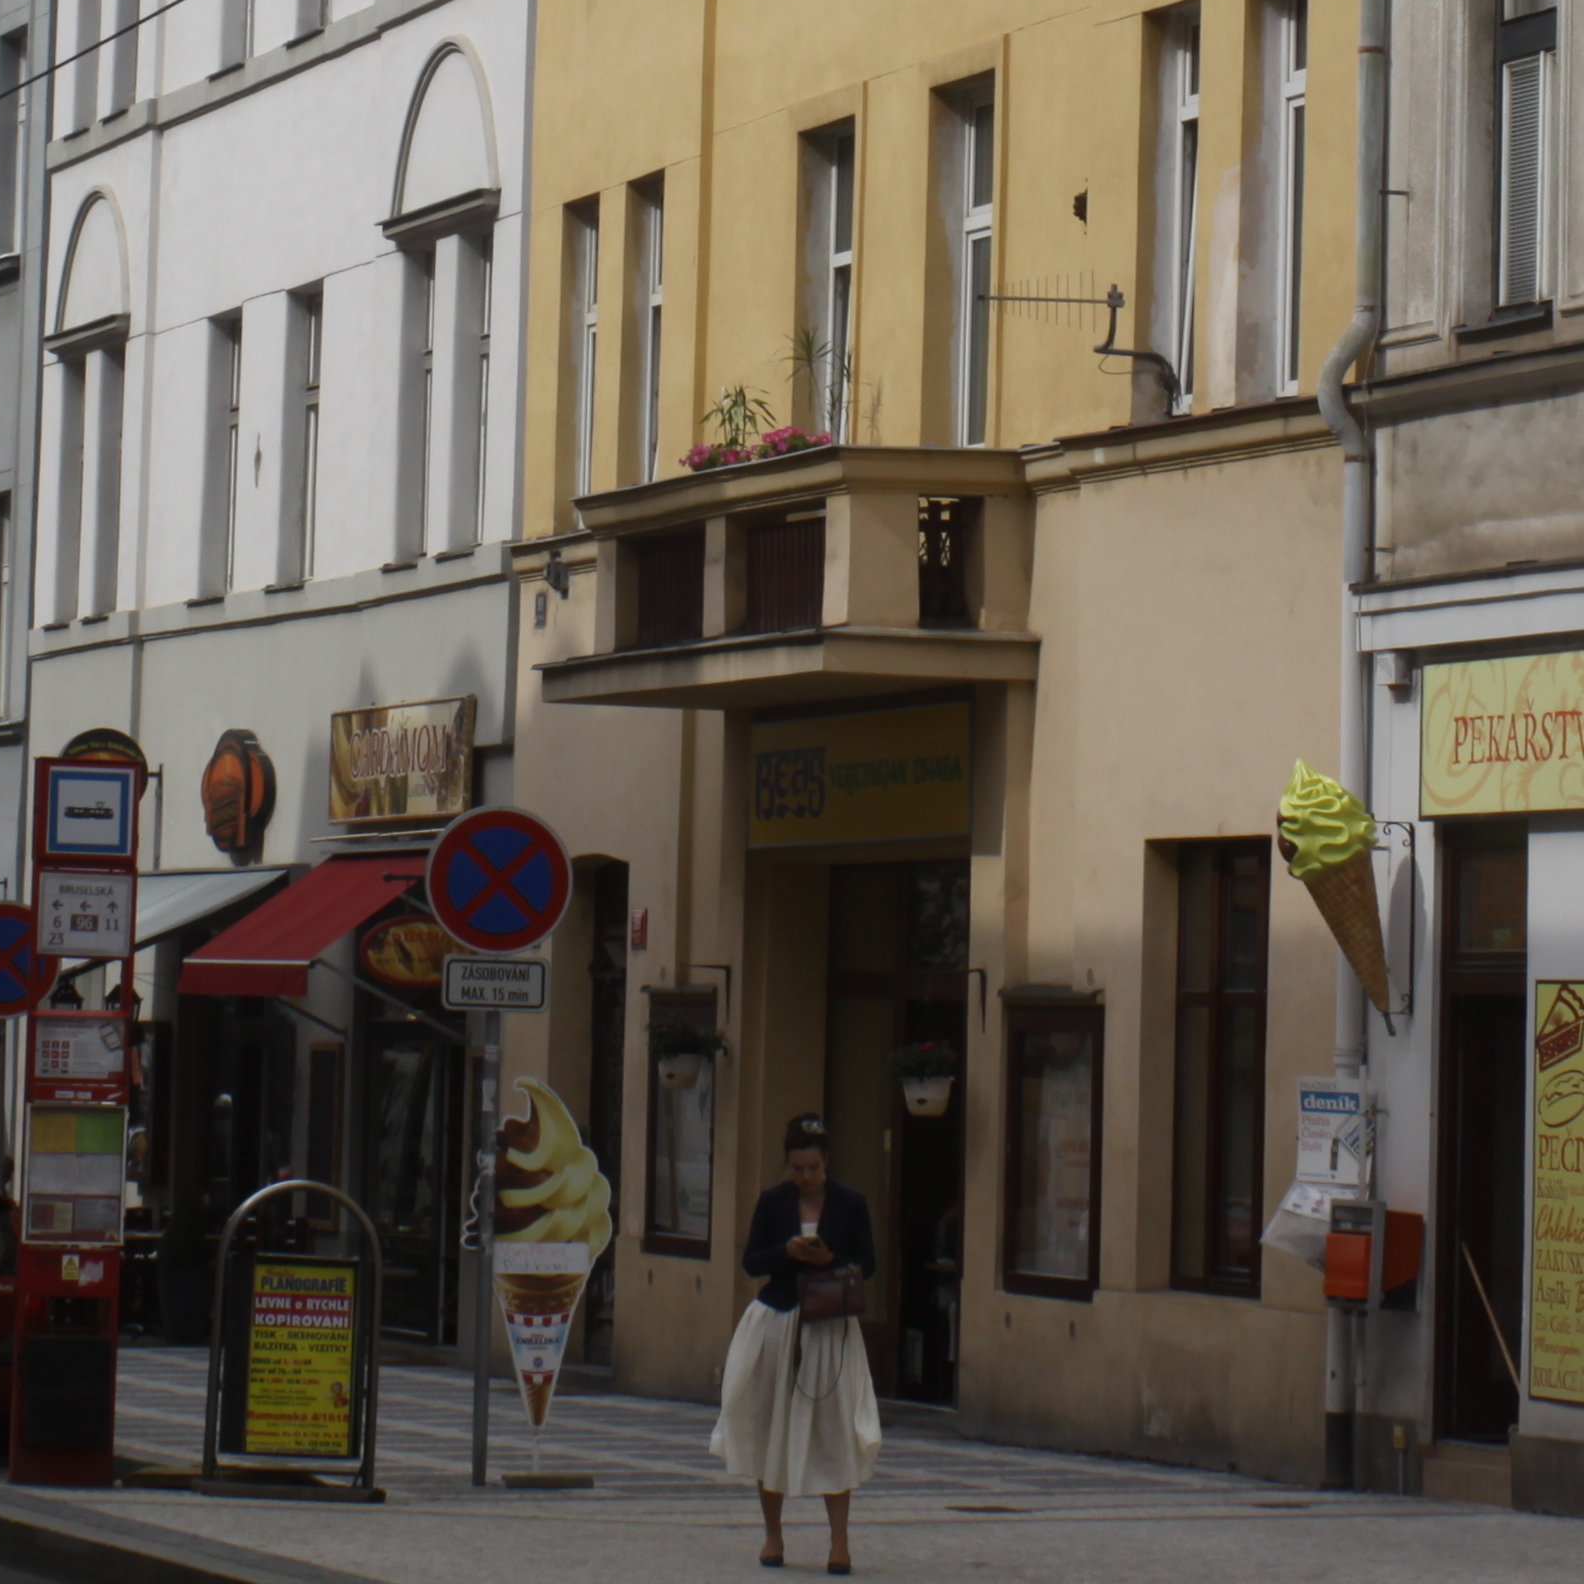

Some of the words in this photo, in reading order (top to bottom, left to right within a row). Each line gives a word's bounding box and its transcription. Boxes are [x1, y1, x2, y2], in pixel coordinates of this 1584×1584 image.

[59, 884, 114, 896] BRUSELSKÁ
[52, 916, 61, 929] 6
[76, 918, 93, 930] 96
[105, 919, 120, 931] 11
[48, 933, 64, 946] 23
[461, 966, 530, 982] ZÁSOBOVÁNÍ
[461, 985, 488, 1001] MAX.
[492, 986, 505, 1001] 15
[508, 989, 528, 1002] min
[1303, 1094, 1356, 1111] deník
[261, 1276, 347, 1293] PLANOGRAFIE
[306, 1299, 350, 1311] RYCHLE
[255, 1312, 349, 1328] KOPÍROVÁNÍ
